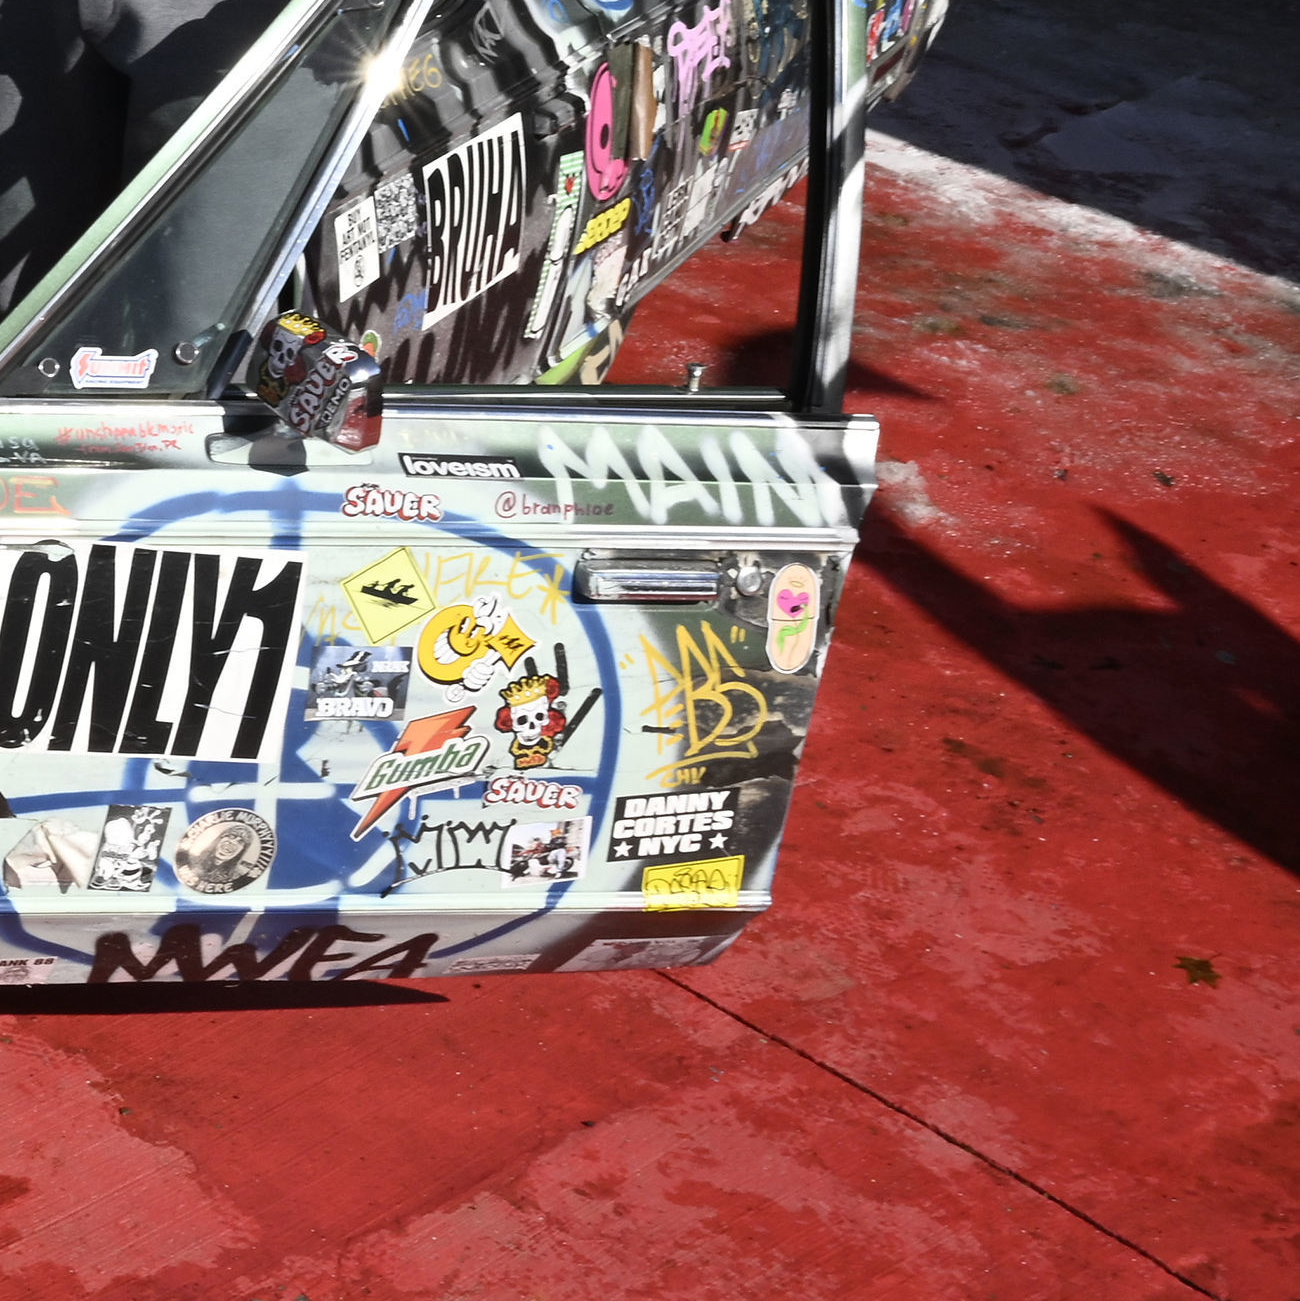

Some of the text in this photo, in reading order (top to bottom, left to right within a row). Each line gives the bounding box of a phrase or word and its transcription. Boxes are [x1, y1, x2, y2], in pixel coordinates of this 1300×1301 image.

[289, 345, 358, 435] SAUER
[536, 424, 842, 527] MAIN
[343, 486, 439, 521] SAUER
[314, 697, 394, 719] BRAVO
[366, 743, 479, 791] Gumba
[485, 776, 583, 810] SAUER
[623, 791, 731, 818] DANNY
[612, 810, 733, 840] CORTES
[638, 834, 702, 857] NYC
